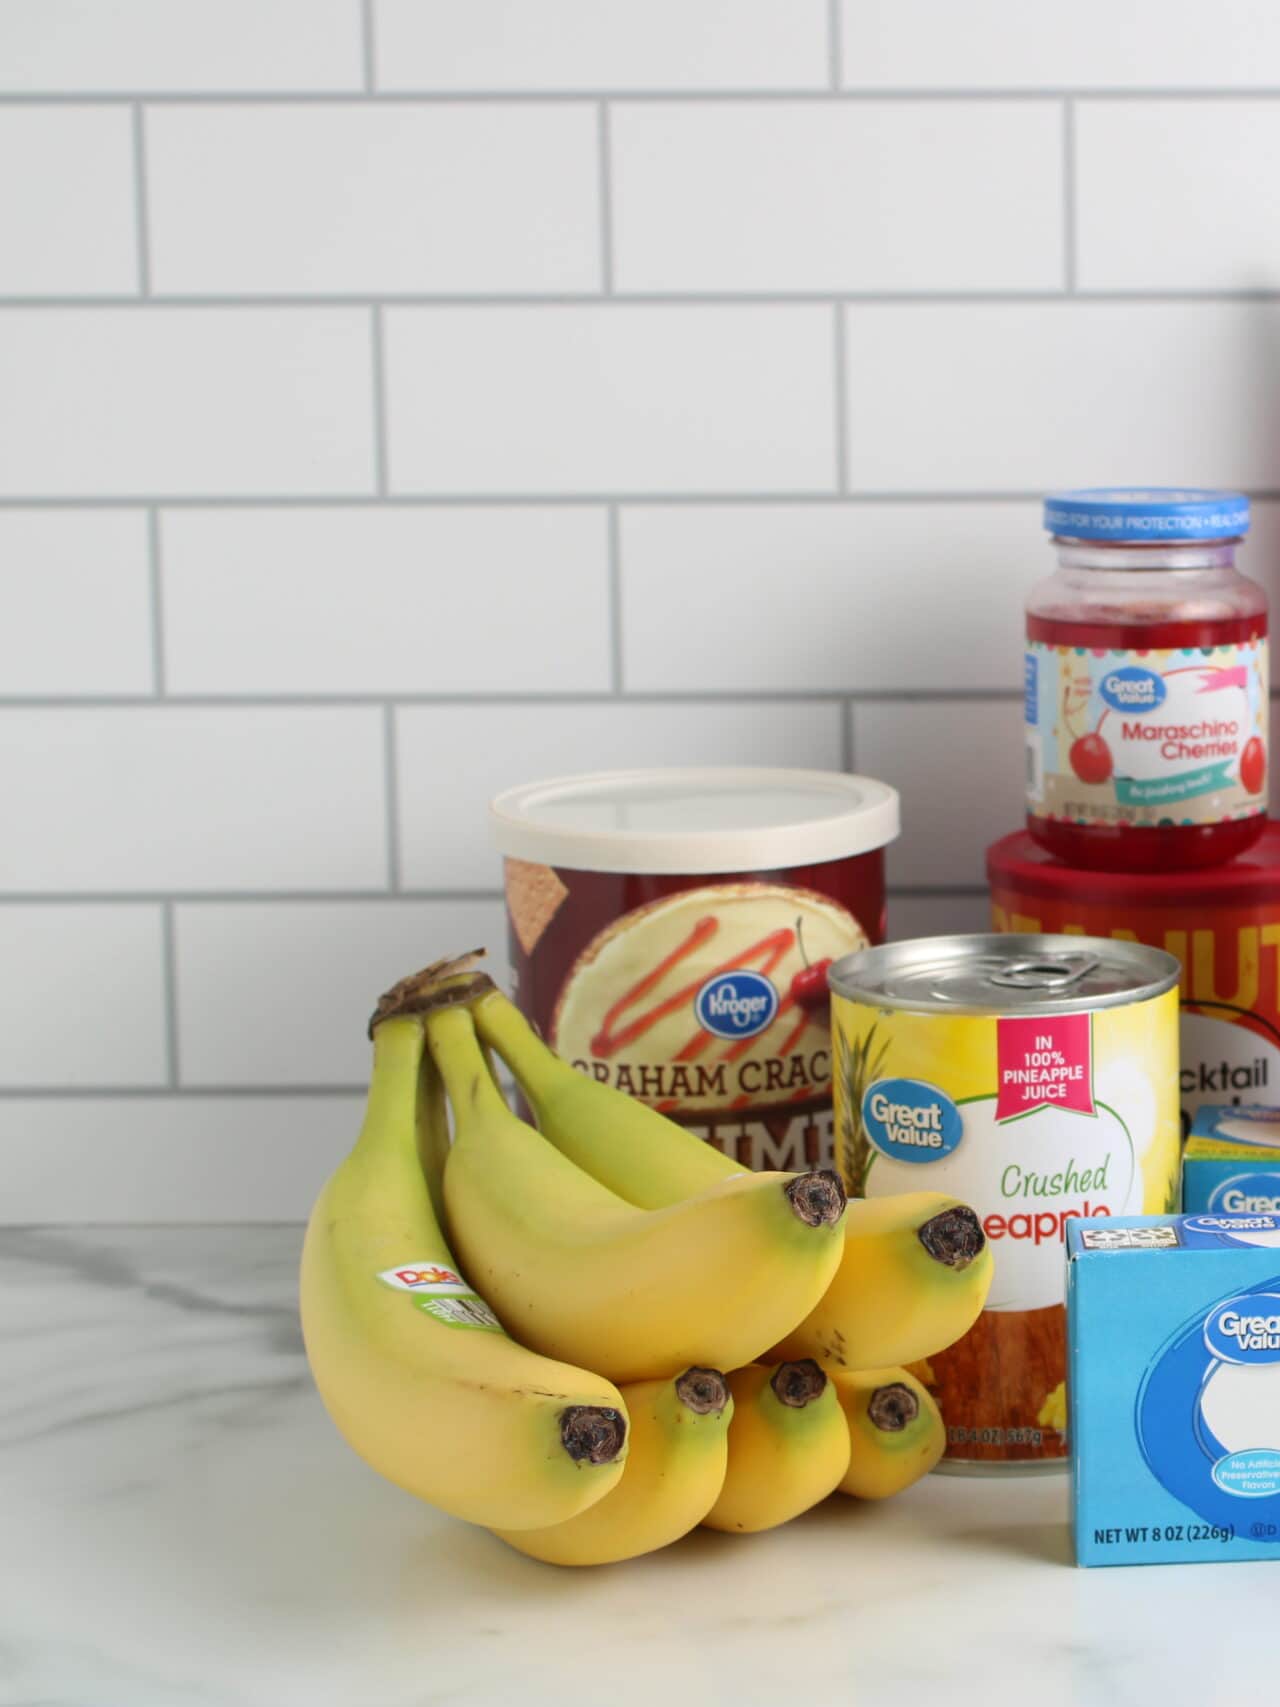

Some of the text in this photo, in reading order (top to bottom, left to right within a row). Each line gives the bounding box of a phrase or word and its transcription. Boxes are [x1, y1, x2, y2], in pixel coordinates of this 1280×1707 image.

[1092, 515, 1123, 529] YOUR
[1127, 515, 1202, 529] PROTECTION
[1106, 676, 1155, 694] Great
[1121, 720, 1239, 742] Maraschino
[1161, 740, 1239, 760] Cherries
[708, 983, 768, 1027] Kroger
[1035, 1036, 1052, 1049] IN
[1024, 1051, 1065, 1066] 100%
[738, 1050, 829, 1094] CRAC
[1003, 1065, 1084, 1084] PINEAPPLE
[1180, 1058, 1269, 1094] cktail
[1021, 1084, 1067, 1100] JUICE
[869, 1094, 943, 1130] Great
[886, 1122, 943, 1149] Value
[1001, 1153, 1111, 1199] Crushed
[1197, 1216, 1274, 1227] Great
[1217, 1221, 1276, 1229] Value
[1231, 1460, 1246, 1470] No
[1242, 1481, 1276, 1490] Flavors
[1094, 1529, 1124, 1545] NET
[1125, 1527, 1149, 1543] WT
[1151, 1527, 1161, 1542] 8
[1164, 1526, 1184, 1541] OZ
[1186, 1523, 1236, 1543] (226g)
